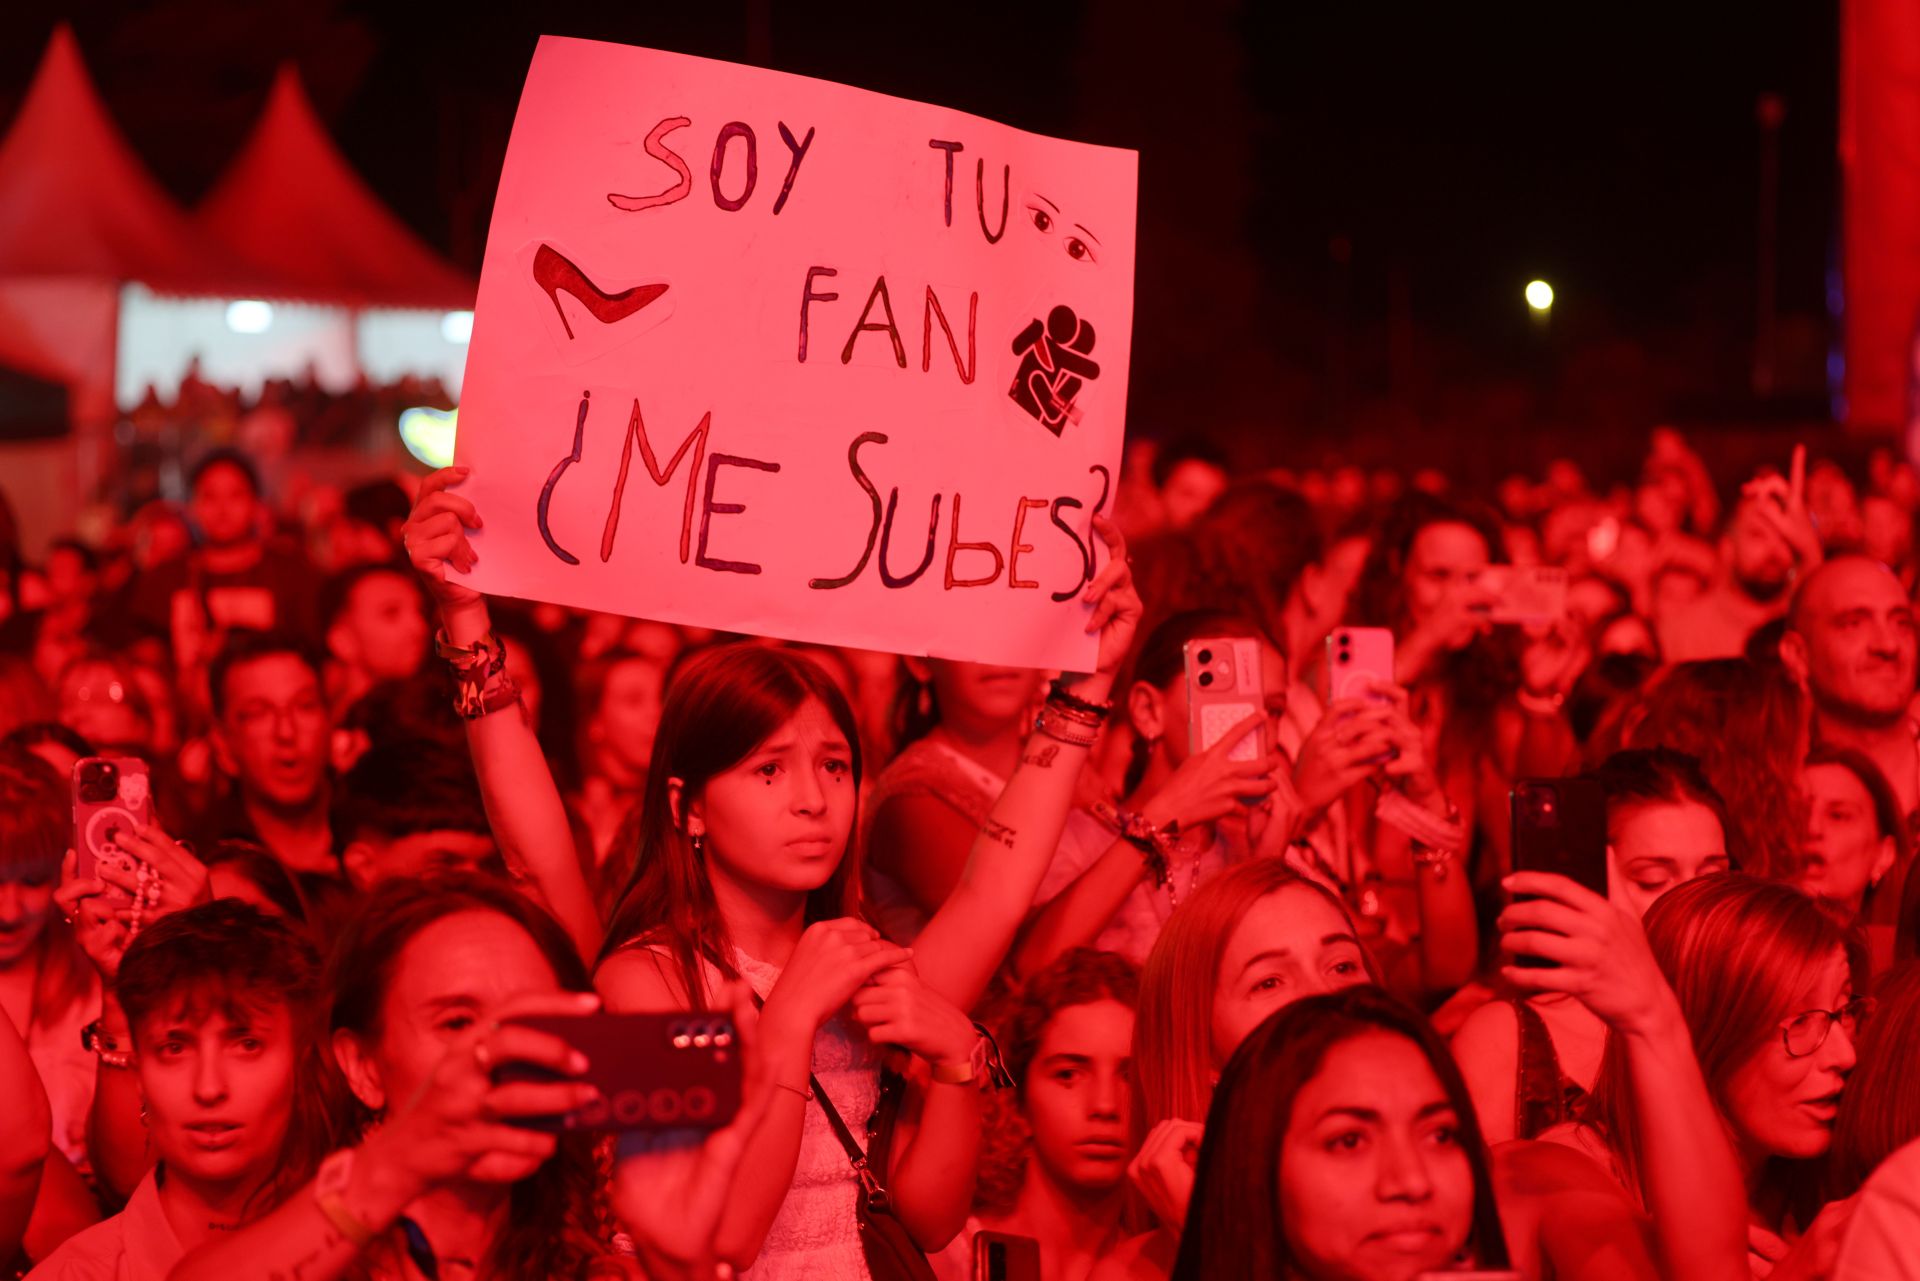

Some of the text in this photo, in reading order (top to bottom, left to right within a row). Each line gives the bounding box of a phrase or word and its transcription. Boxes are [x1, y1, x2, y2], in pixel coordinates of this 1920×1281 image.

[607, 115, 1011, 245] SOY TU
[798, 265, 979, 385] FAN
